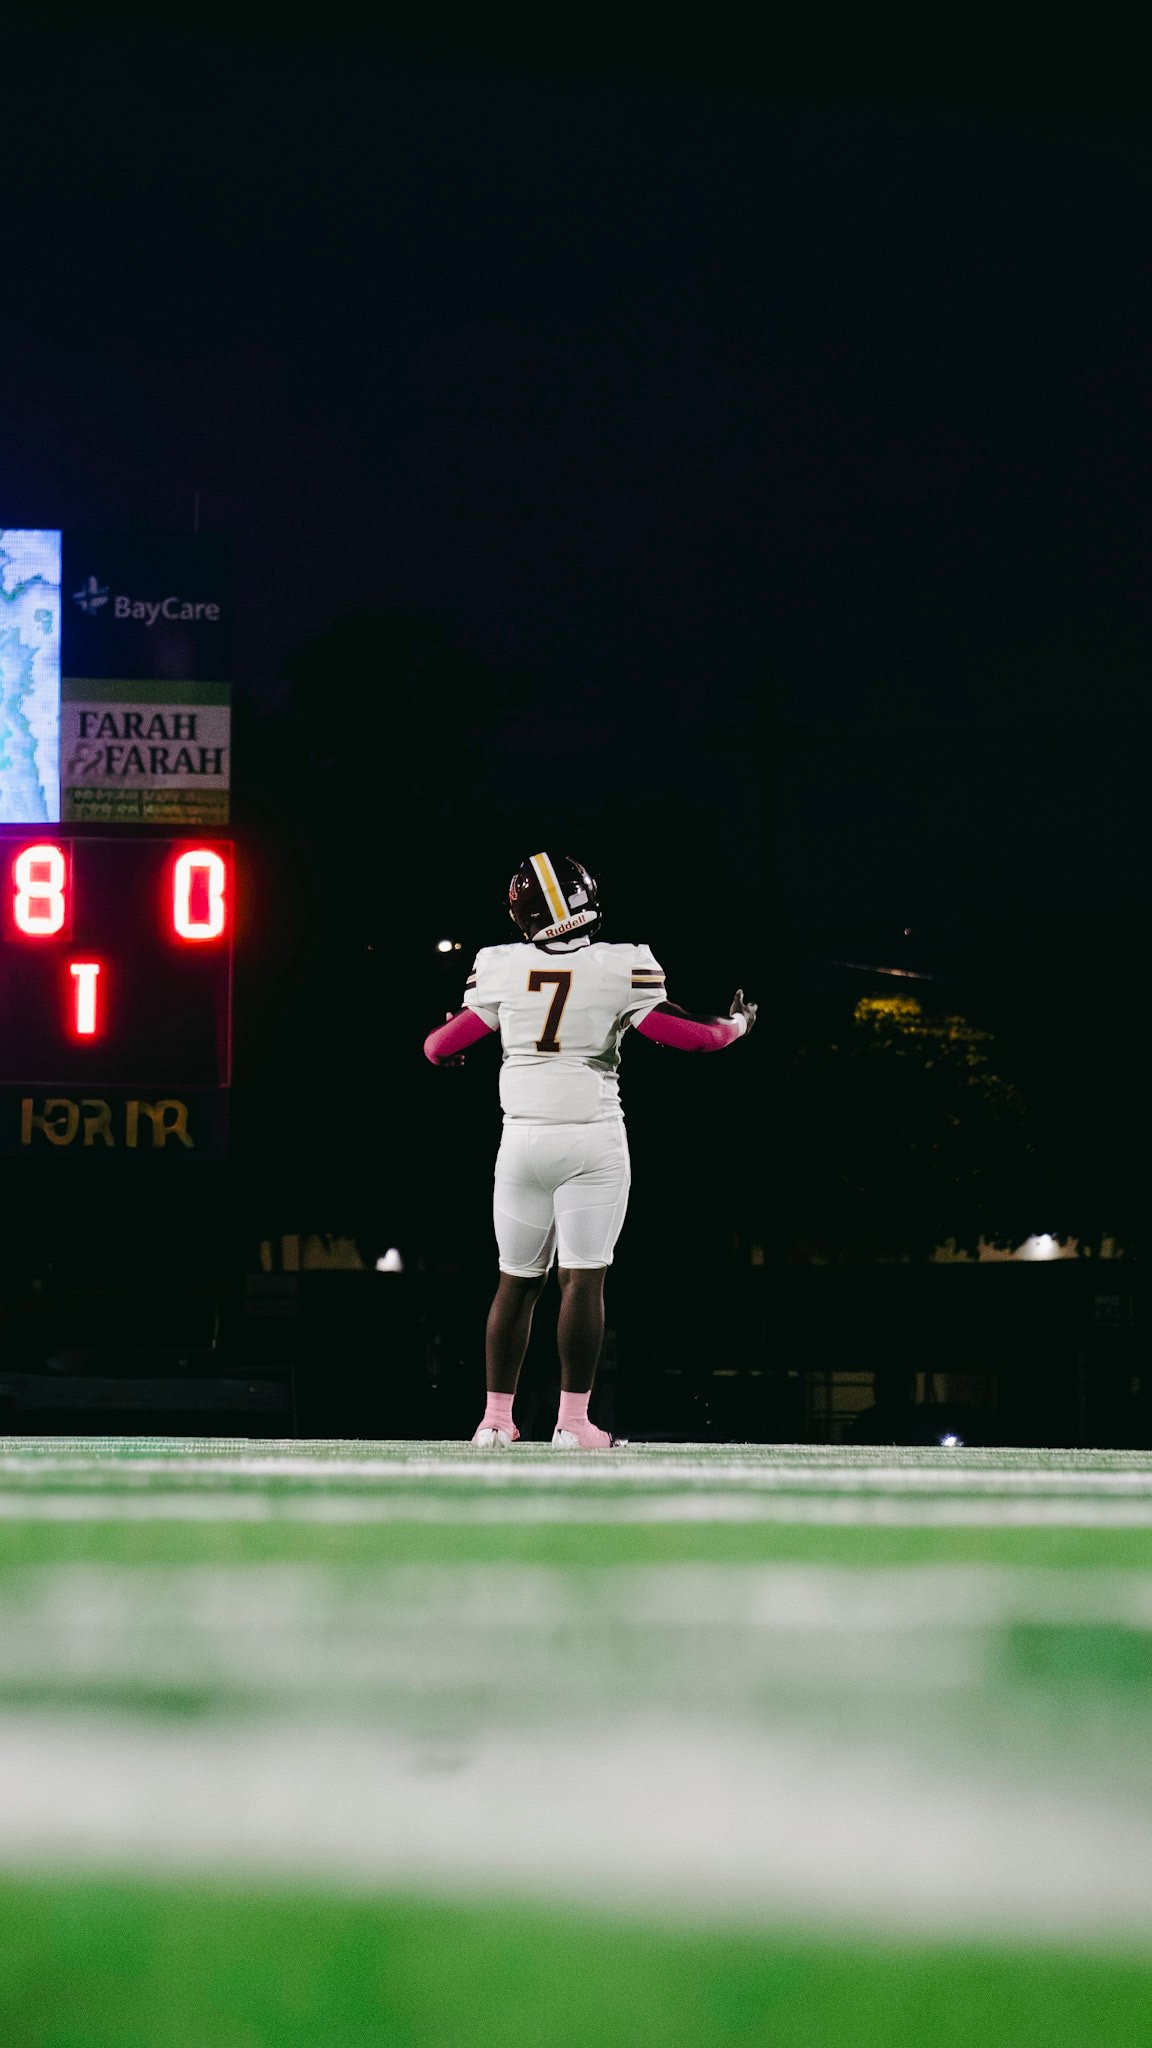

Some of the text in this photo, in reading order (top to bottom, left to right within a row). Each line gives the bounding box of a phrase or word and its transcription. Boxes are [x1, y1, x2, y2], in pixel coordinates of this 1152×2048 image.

[114, 595, 221, 626] BayCare
[78, 711, 197, 741] FARAH
[105, 745, 225, 775] FARAH
[14, 845, 65, 935] 8
[173, 850, 225, 939] 0
[545, 914, 587, 938] Riddell
[528, 969, 572, 1053] 7
